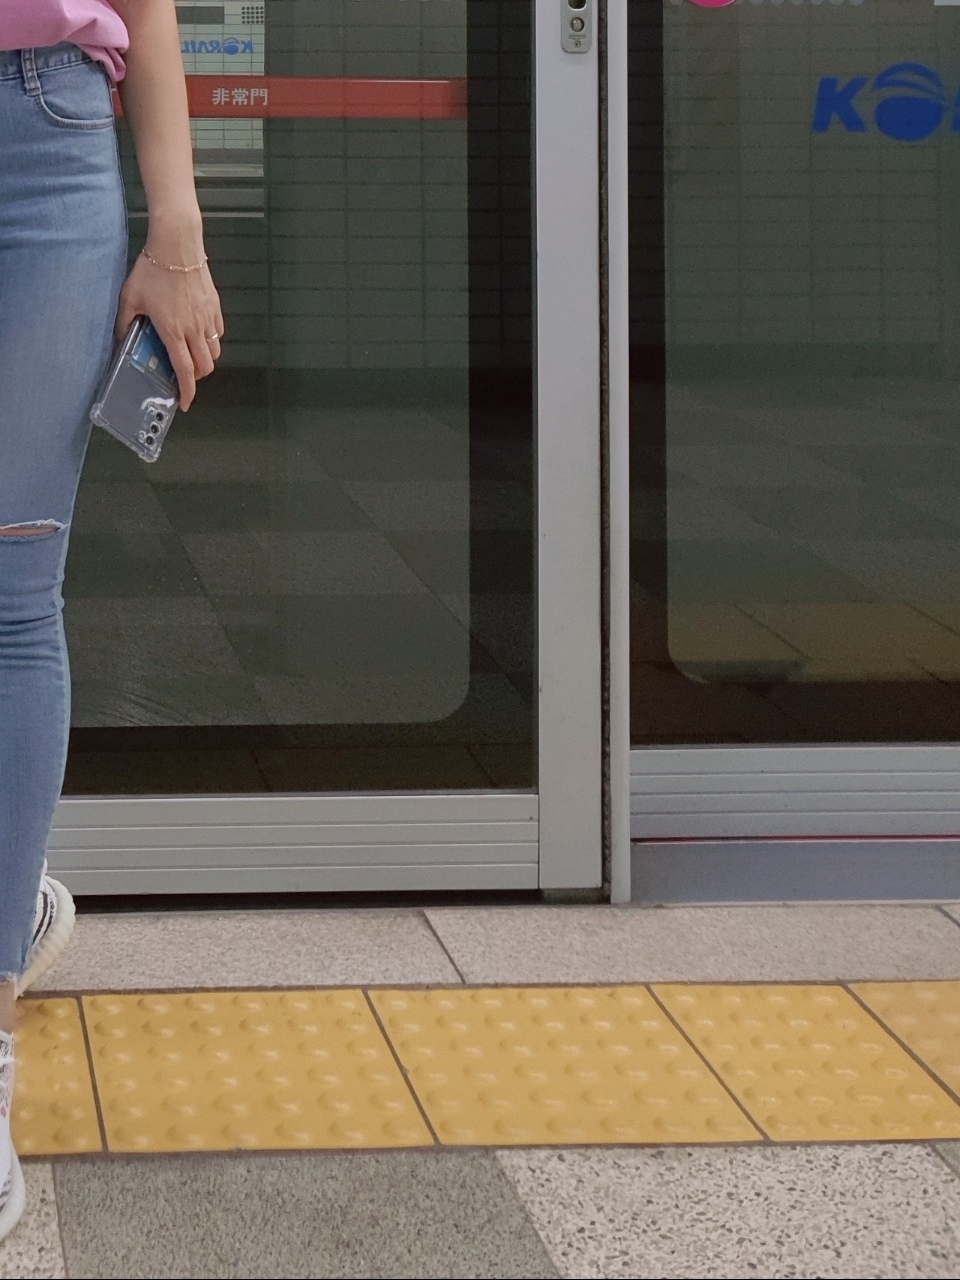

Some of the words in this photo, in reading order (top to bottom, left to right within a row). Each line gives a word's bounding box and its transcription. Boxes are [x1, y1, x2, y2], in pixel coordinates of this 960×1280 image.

[212, 88, 268, 106] 非常門
[812, 62, 960, 142] KO
